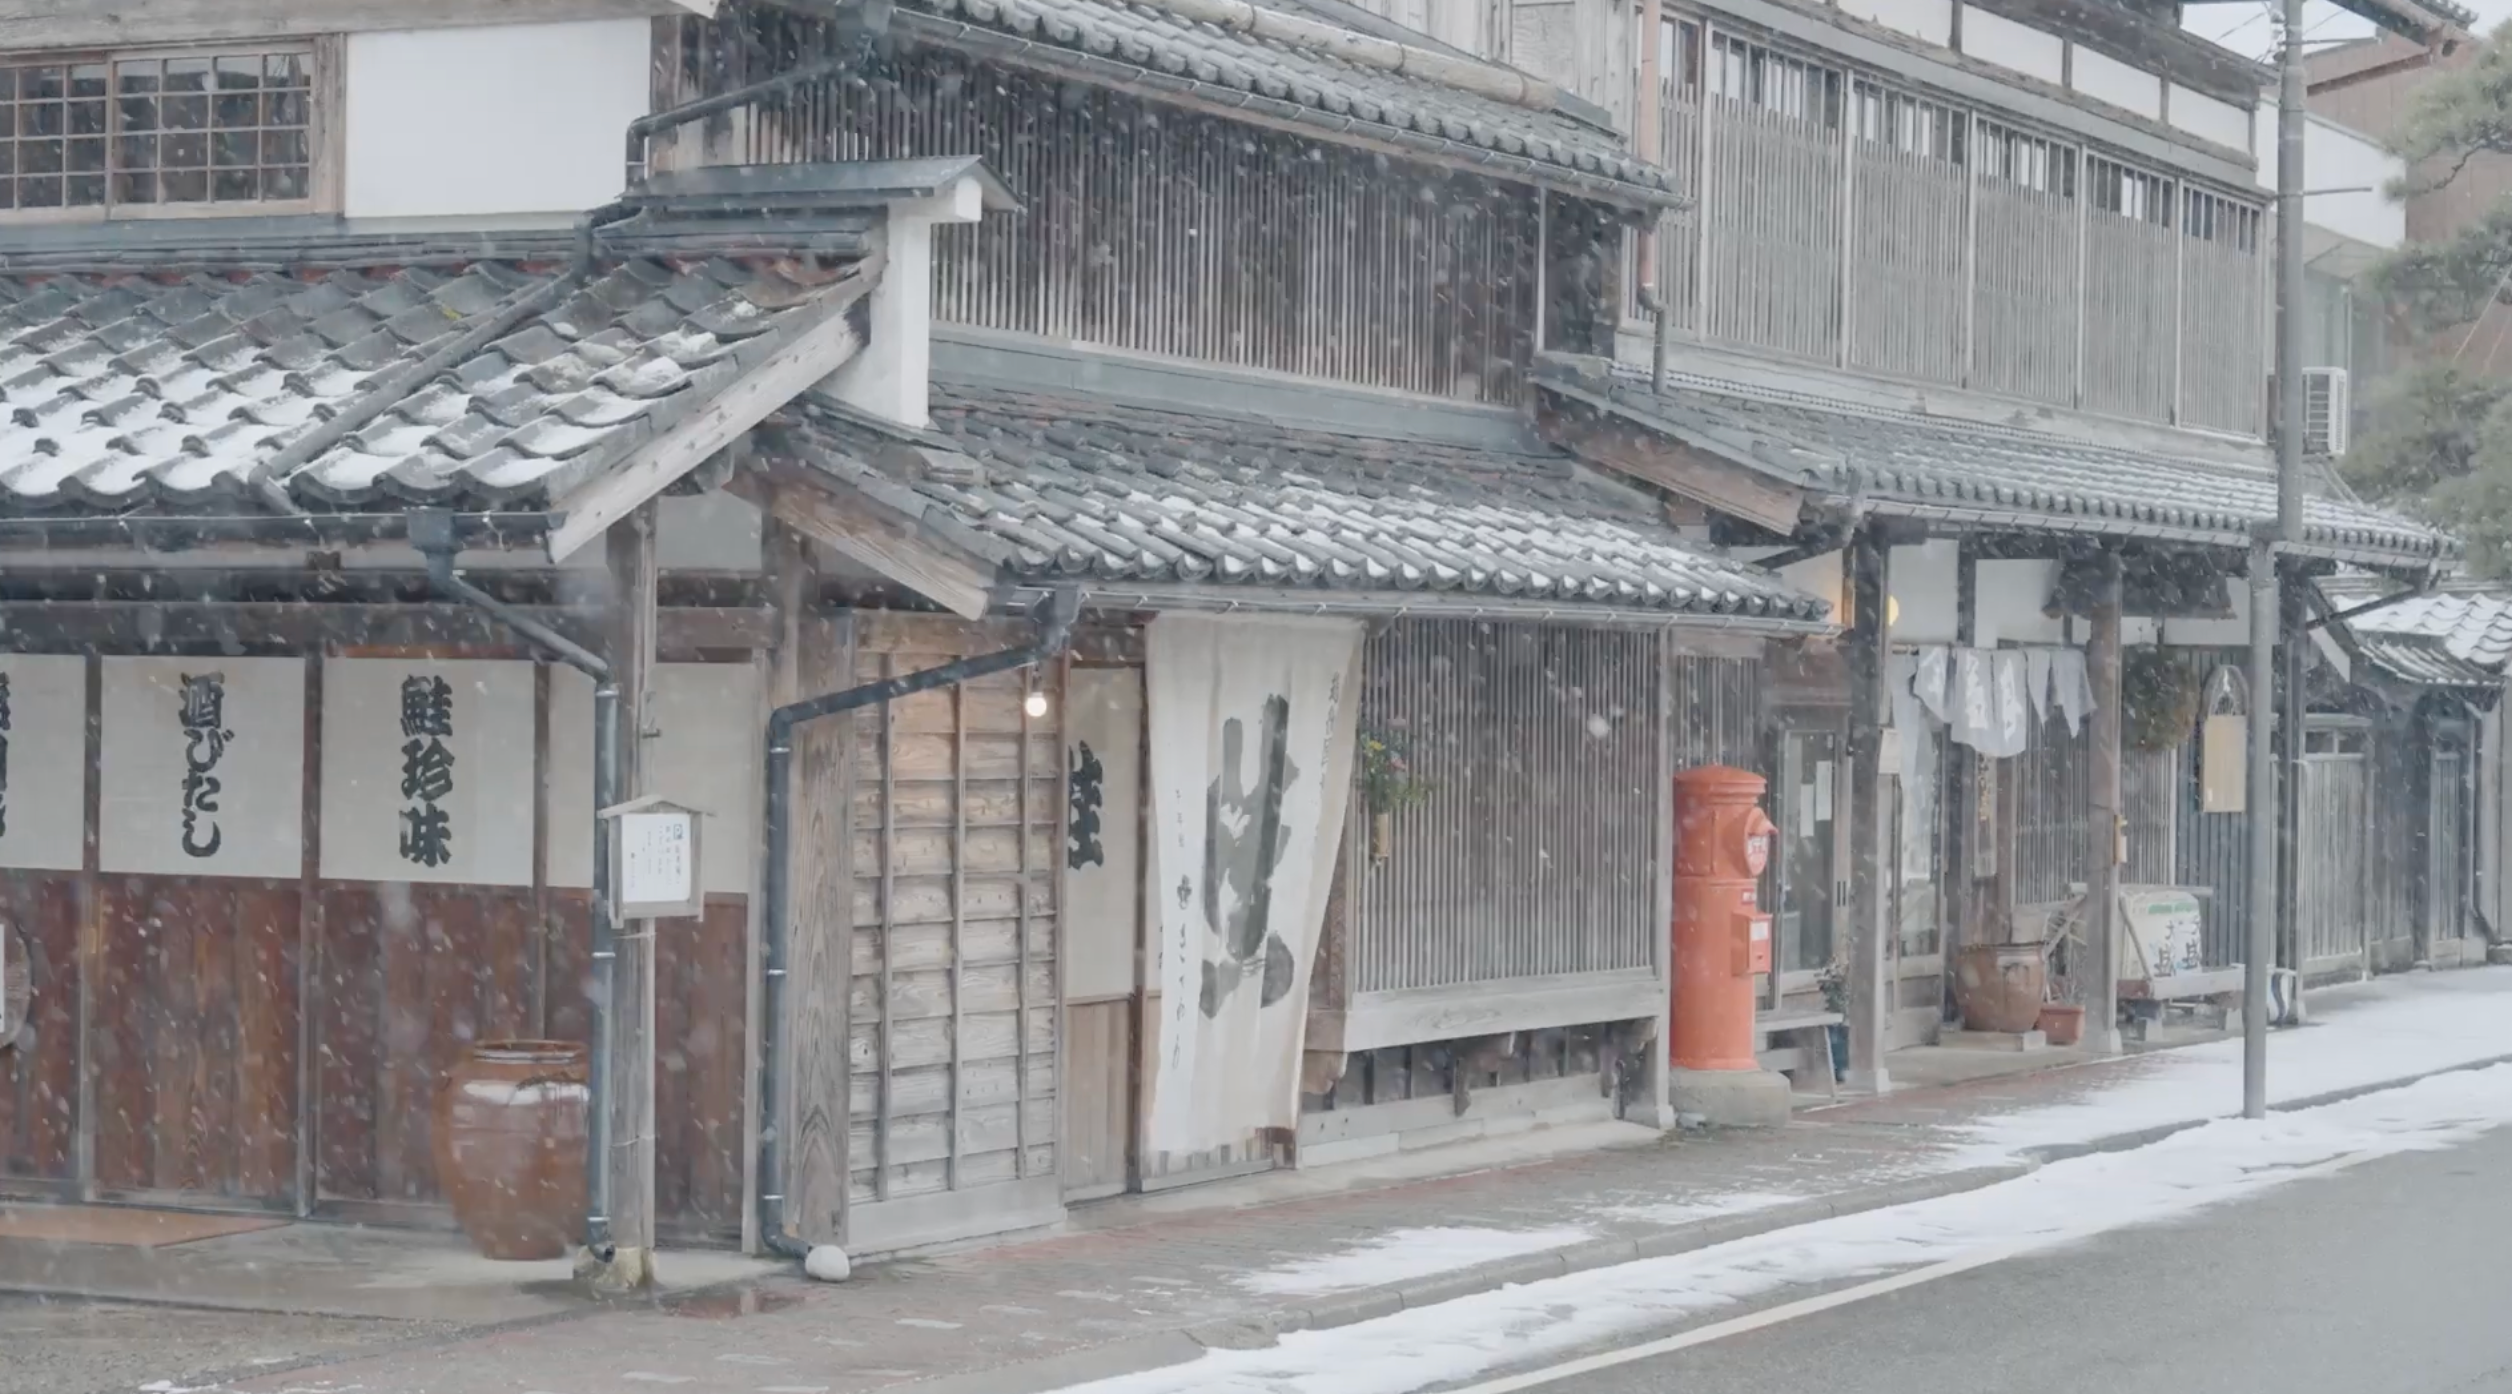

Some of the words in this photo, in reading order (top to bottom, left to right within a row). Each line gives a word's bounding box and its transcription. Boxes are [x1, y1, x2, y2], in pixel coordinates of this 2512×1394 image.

[178, 671, 235, 858] 酒びたし
[399, 673, 455, 868] 鮭珍味
